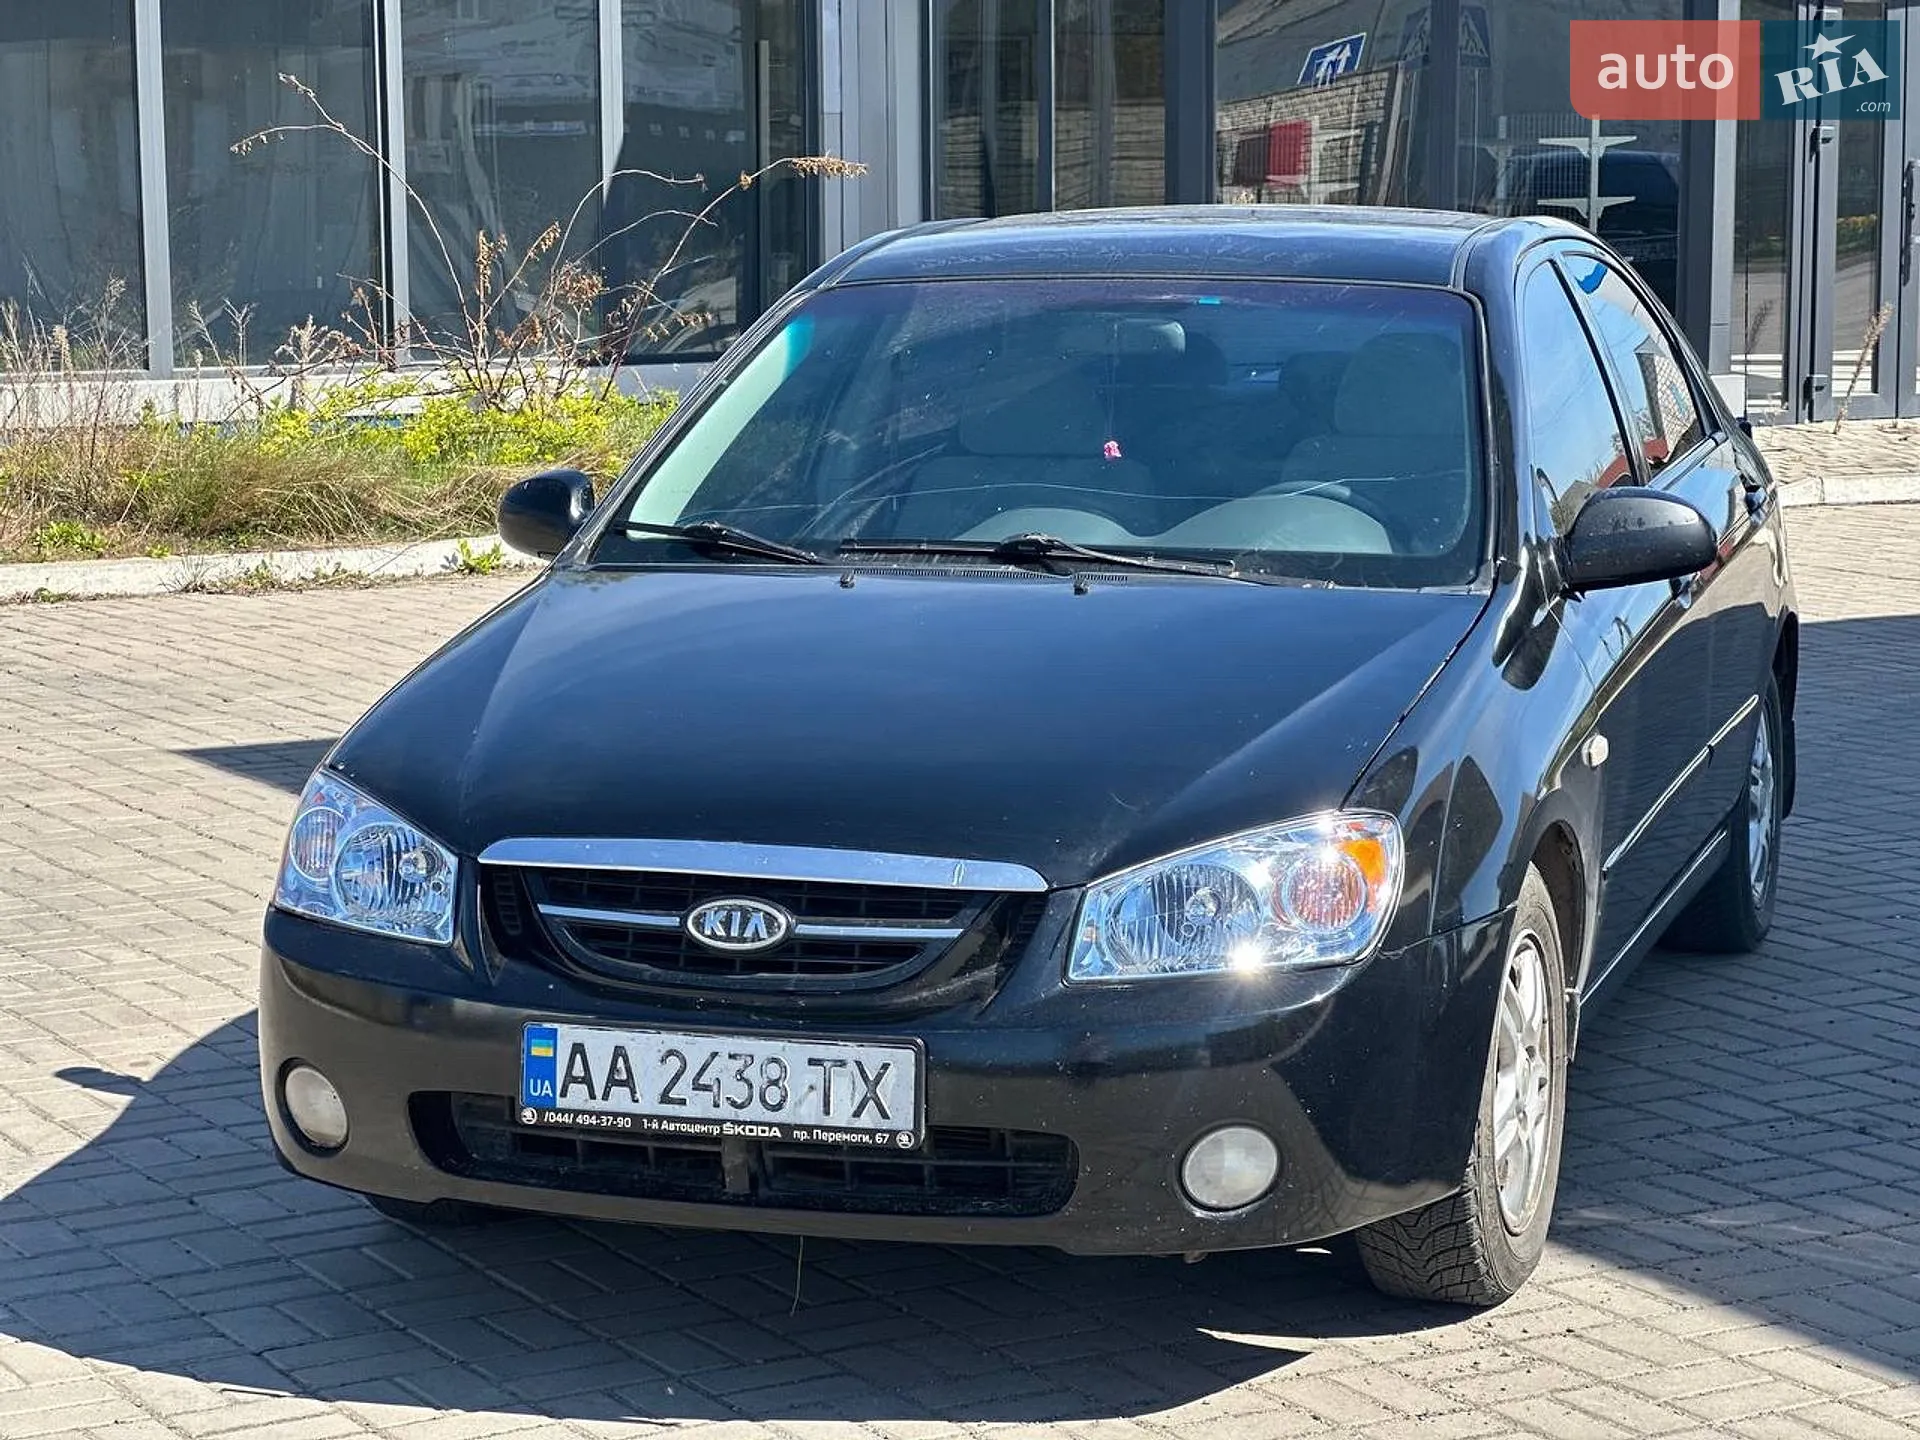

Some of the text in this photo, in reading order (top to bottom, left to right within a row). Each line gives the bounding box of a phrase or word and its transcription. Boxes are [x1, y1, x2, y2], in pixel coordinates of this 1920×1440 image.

[703, 910, 768, 939] KIA
[529, 1078, 553, 1097] UA
[559, 1042, 891, 1120] AA 2438 TX
[576, 1113, 632, 1128] 494-37-90
[642, 1118, 659, 1130] 1-й
[661, 1122, 721, 1136] Автоцентр
[722, 1122, 782, 1138] ŠKODA
[793, 1129, 810, 1142] пр.
[812, 1129, 873, 1144] Перемоги,
[875, 1132, 890, 1145] 67
